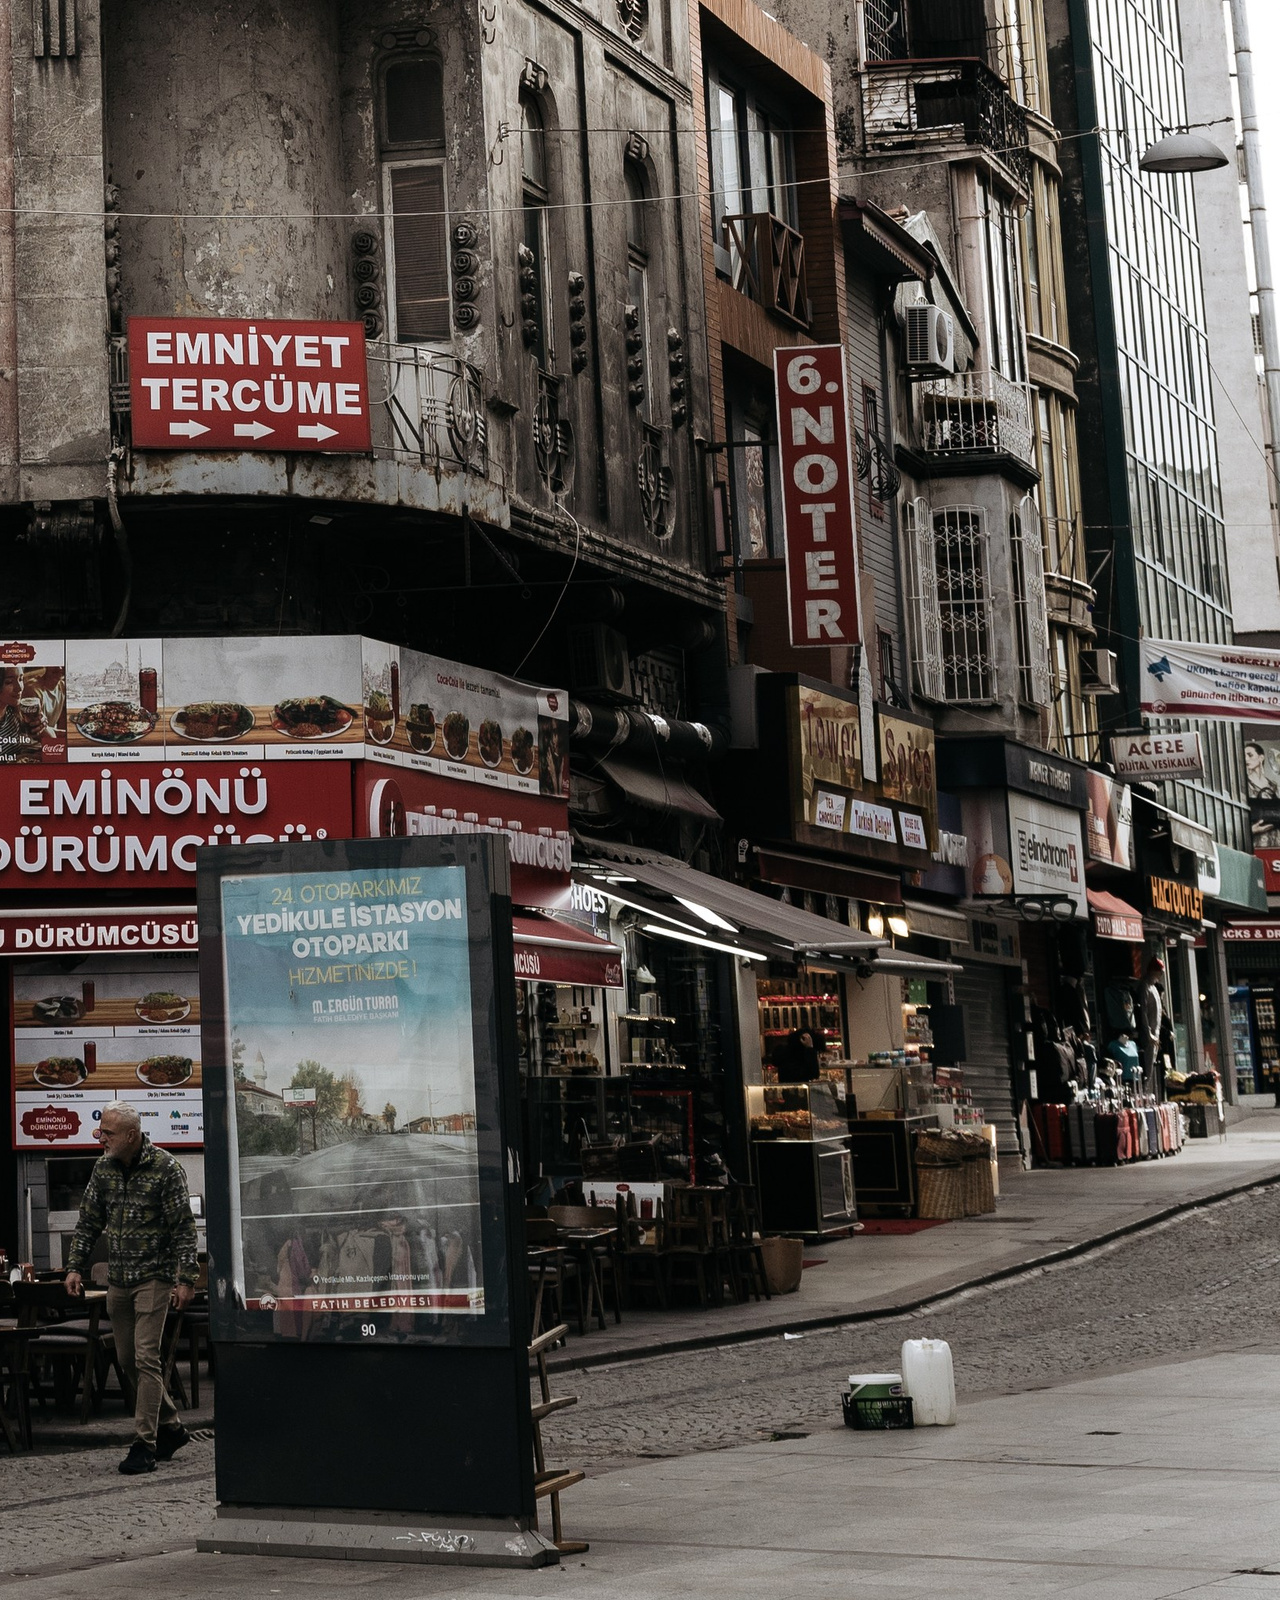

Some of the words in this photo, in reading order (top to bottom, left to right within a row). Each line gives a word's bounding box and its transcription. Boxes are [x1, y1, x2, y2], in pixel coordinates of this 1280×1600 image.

[147, 326, 349, 368] EMNİYET
[141, 373, 362, 415] TERCÜME
[885, 728, 932, 797] Spice
[1151, 757, 1197, 770] VESİKALIK
[20, 767, 268, 816] EMİNÖNÜ
[825, 796, 834, 809] TEA
[271, 887, 298, 906] 24.
[300, 876, 424, 904] OTOPARKIMIZ
[1172, 880, 1204, 921] OUTLET
[236, 905, 347, 936] YEDİKULE
[349, 898, 462, 928] İSTASYON
[15, 921, 199, 949] DÜRÜMCÜSÜ
[292, 929, 409, 959] OTOPARKI
[288, 960, 410, 987] HİZMETİNİZDE
[312, 1298, 349, 1310] FATİH
[354, 1296, 431, 1309] BELEDİYESİ
[361, 1323, 376, 1337] 90
